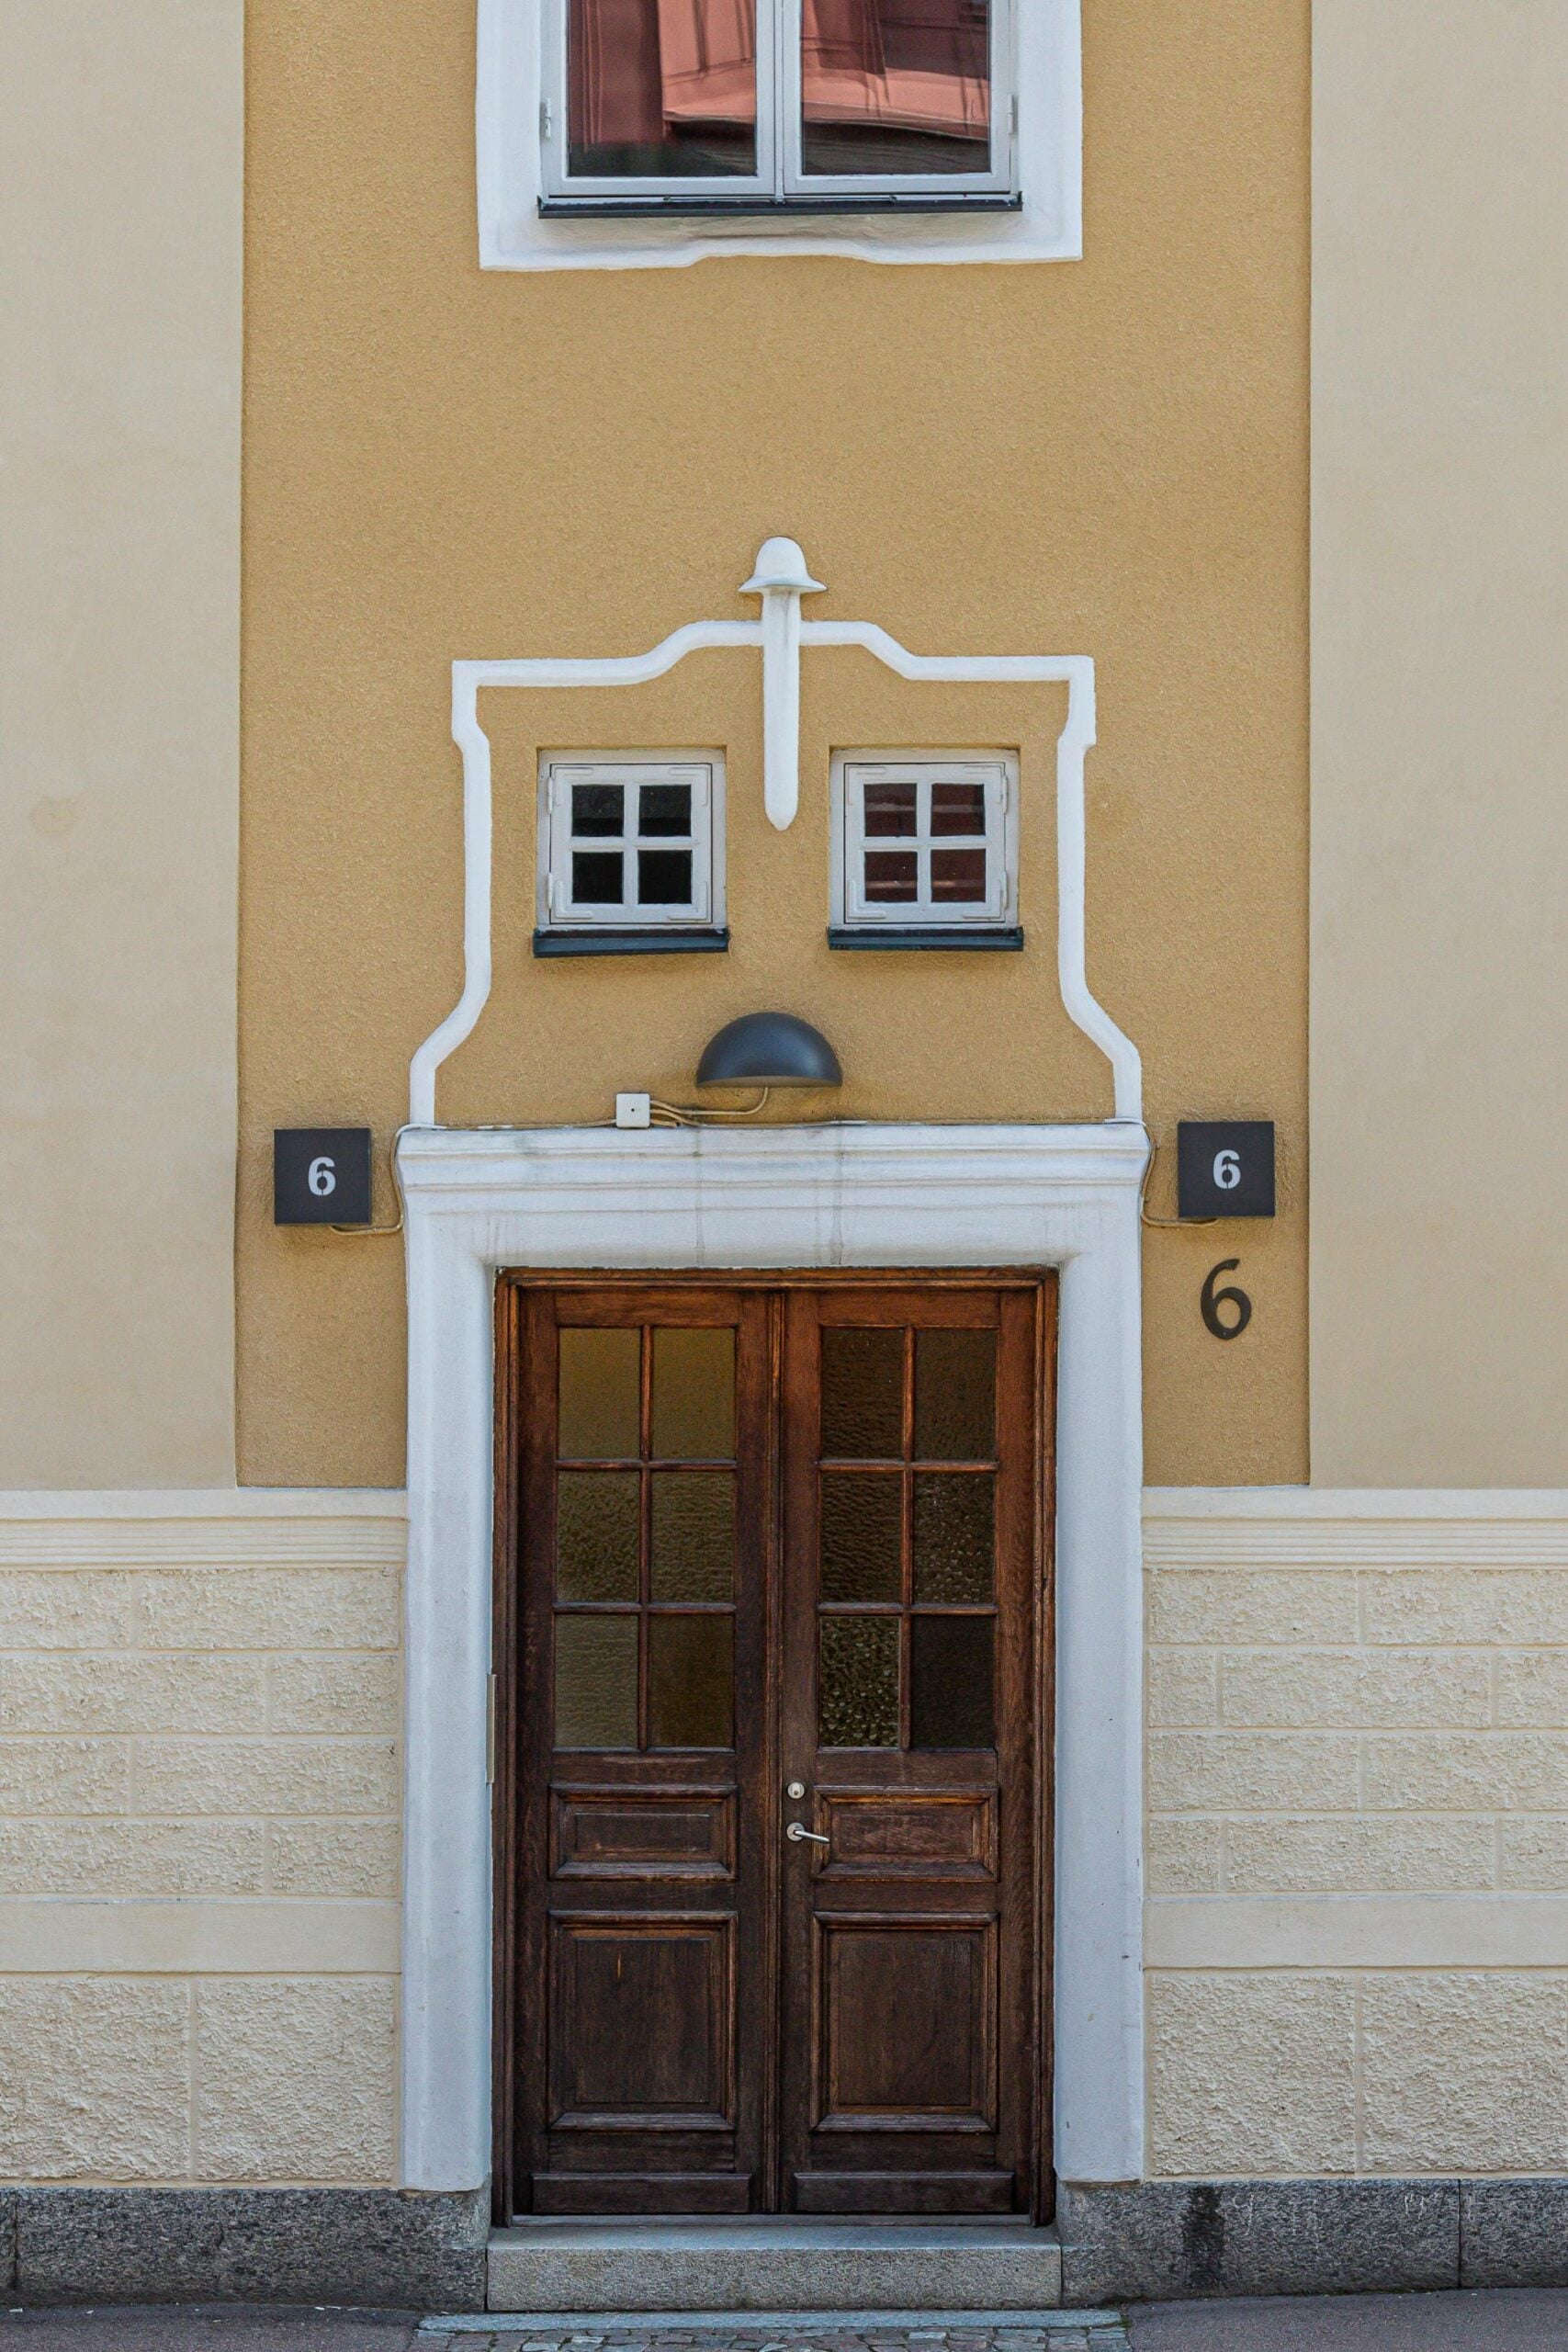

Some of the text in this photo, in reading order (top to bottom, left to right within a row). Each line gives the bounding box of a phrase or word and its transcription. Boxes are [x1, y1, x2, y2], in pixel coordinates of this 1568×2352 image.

[308, 1156, 336, 1196] 6
[1213, 1149, 1241, 1190] 6
[1200, 1258, 1253, 1341] 6
